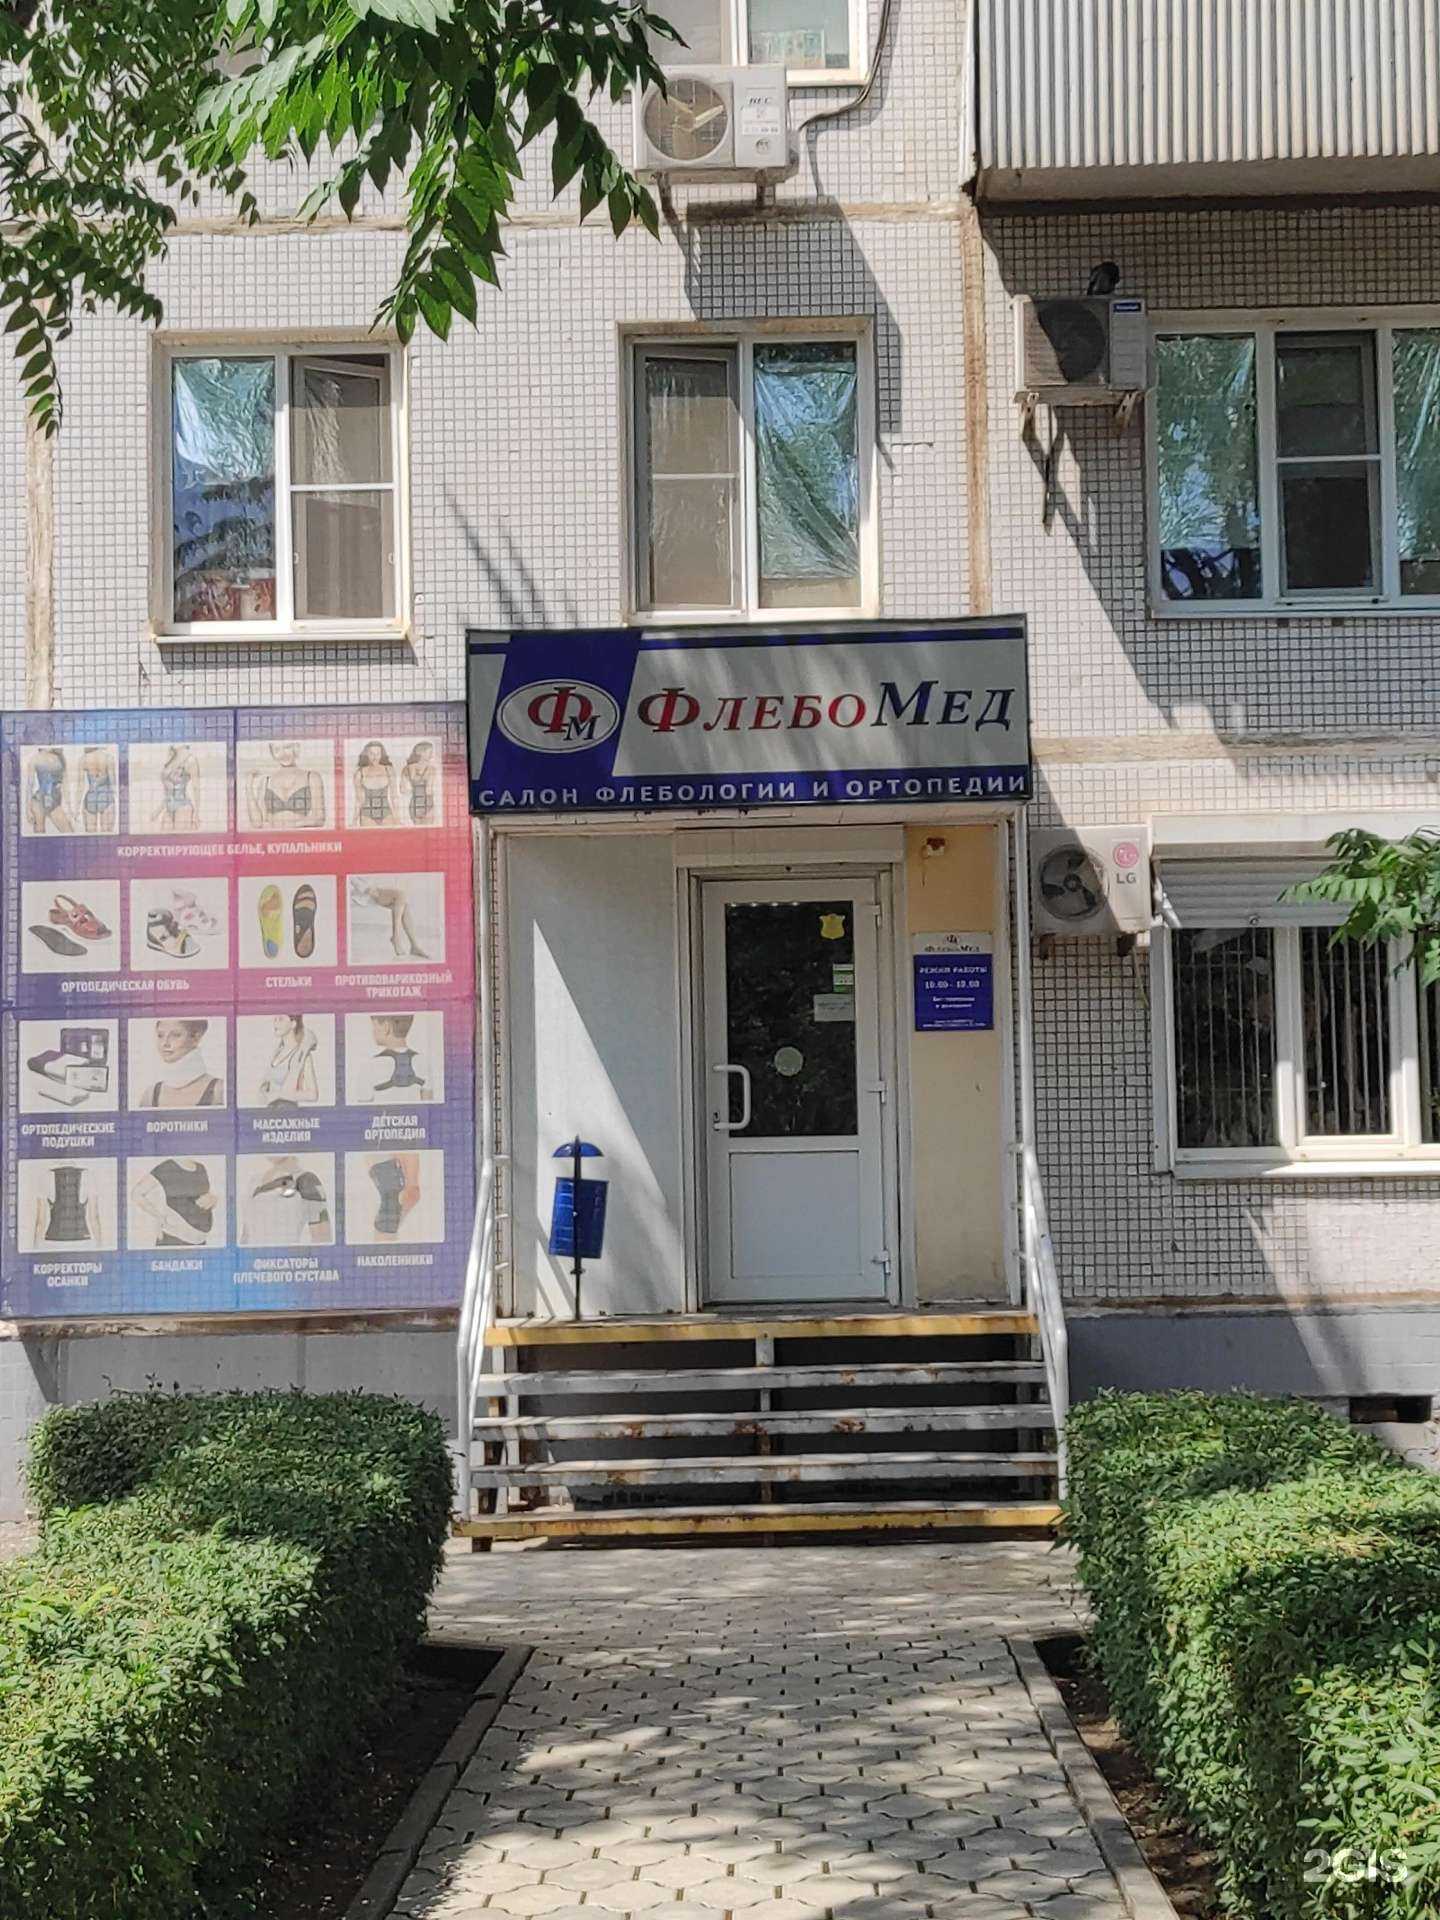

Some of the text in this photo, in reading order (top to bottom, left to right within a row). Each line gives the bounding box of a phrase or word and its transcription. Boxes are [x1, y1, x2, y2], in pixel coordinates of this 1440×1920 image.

[479, 775, 1026, 807] САЛОН ФЛЕБОЛОГИИ И ОРТОПЕДИИ
[117, 844, 225, 857] КОРРЕКТИРУЮЩЕЕ
[267, 840, 342, 855] КУПАЛЬНИКИ
[1116, 873, 1137, 884] LG
[265, 976, 313, 988] СТЕЛЬКИ
[335, 970, 453, 986] ПРОТИВОВАРИКОЗНЫЙ
[61, 979, 190, 993] ОРТОПЕДИЧЕСКАЯ ОБУВЬ
[366, 986, 422, 998] ТРИКОТАЖ
[146, 1120, 208, 1133] ВОРОТНИКИ
[253, 1117, 321, 1131] МАССАЖНЫЕ
[371, 1115, 419, 1128] ДЕТСКАЯ
[21, 1122, 115, 1136] ОРТОПЕДИЧЕСКИЕ
[364, 1128, 426, 1141] ОРТОПЕДИЯ
[41, 1135, 95, 1148] ПОДУШКИ
[262, 1130, 311, 1143] ИЗДЕЛИЯ
[151, 1259, 203, 1272] БАНДАЖИ
[254, 1257, 318, 1270] ФИКСАТОРЫ
[356, 1254, 433, 1267] НАКОЛЕННИКИ
[33, 1262, 102, 1275] КОРРЕКТОРЫ
[46, 1275, 88, 1288] ОСАНКИ
[233, 1270, 340, 1284] ПЛЕЧЕВОГО СУСТАВА
